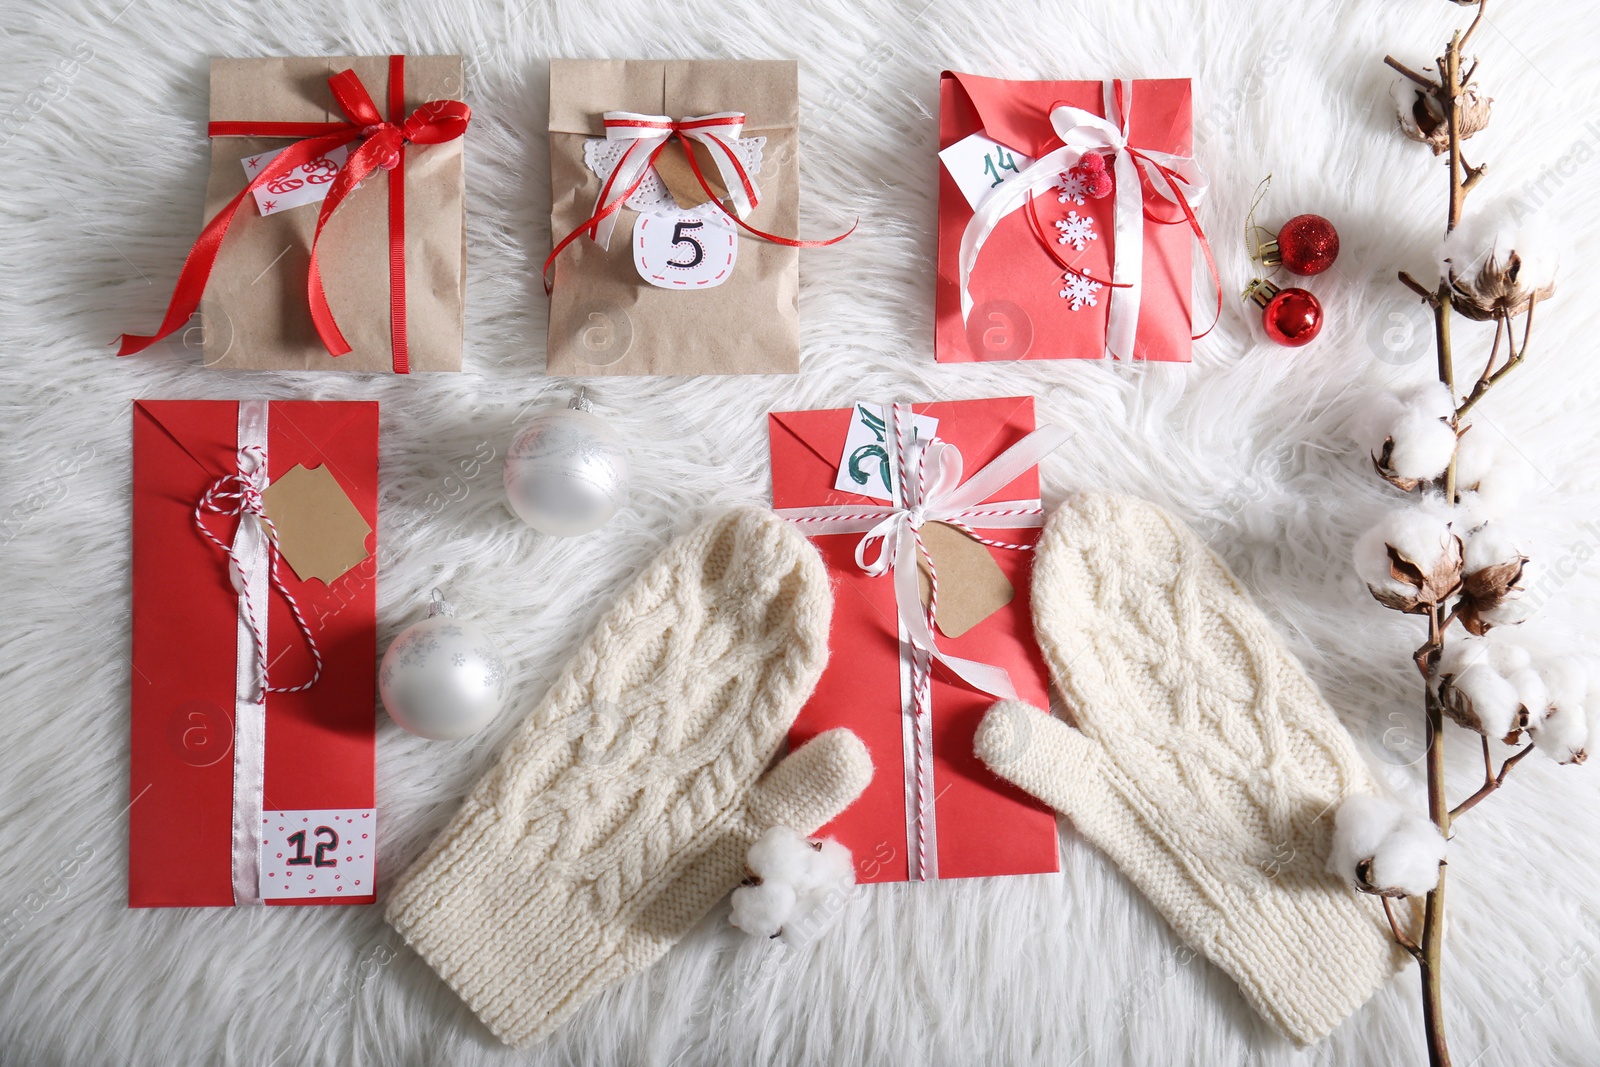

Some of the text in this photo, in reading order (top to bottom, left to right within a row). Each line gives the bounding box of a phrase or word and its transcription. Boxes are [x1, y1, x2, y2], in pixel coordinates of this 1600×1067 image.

[984, 145, 1019, 188] 14
[667, 221, 704, 268] 5
[286, 825, 340, 868] 12
